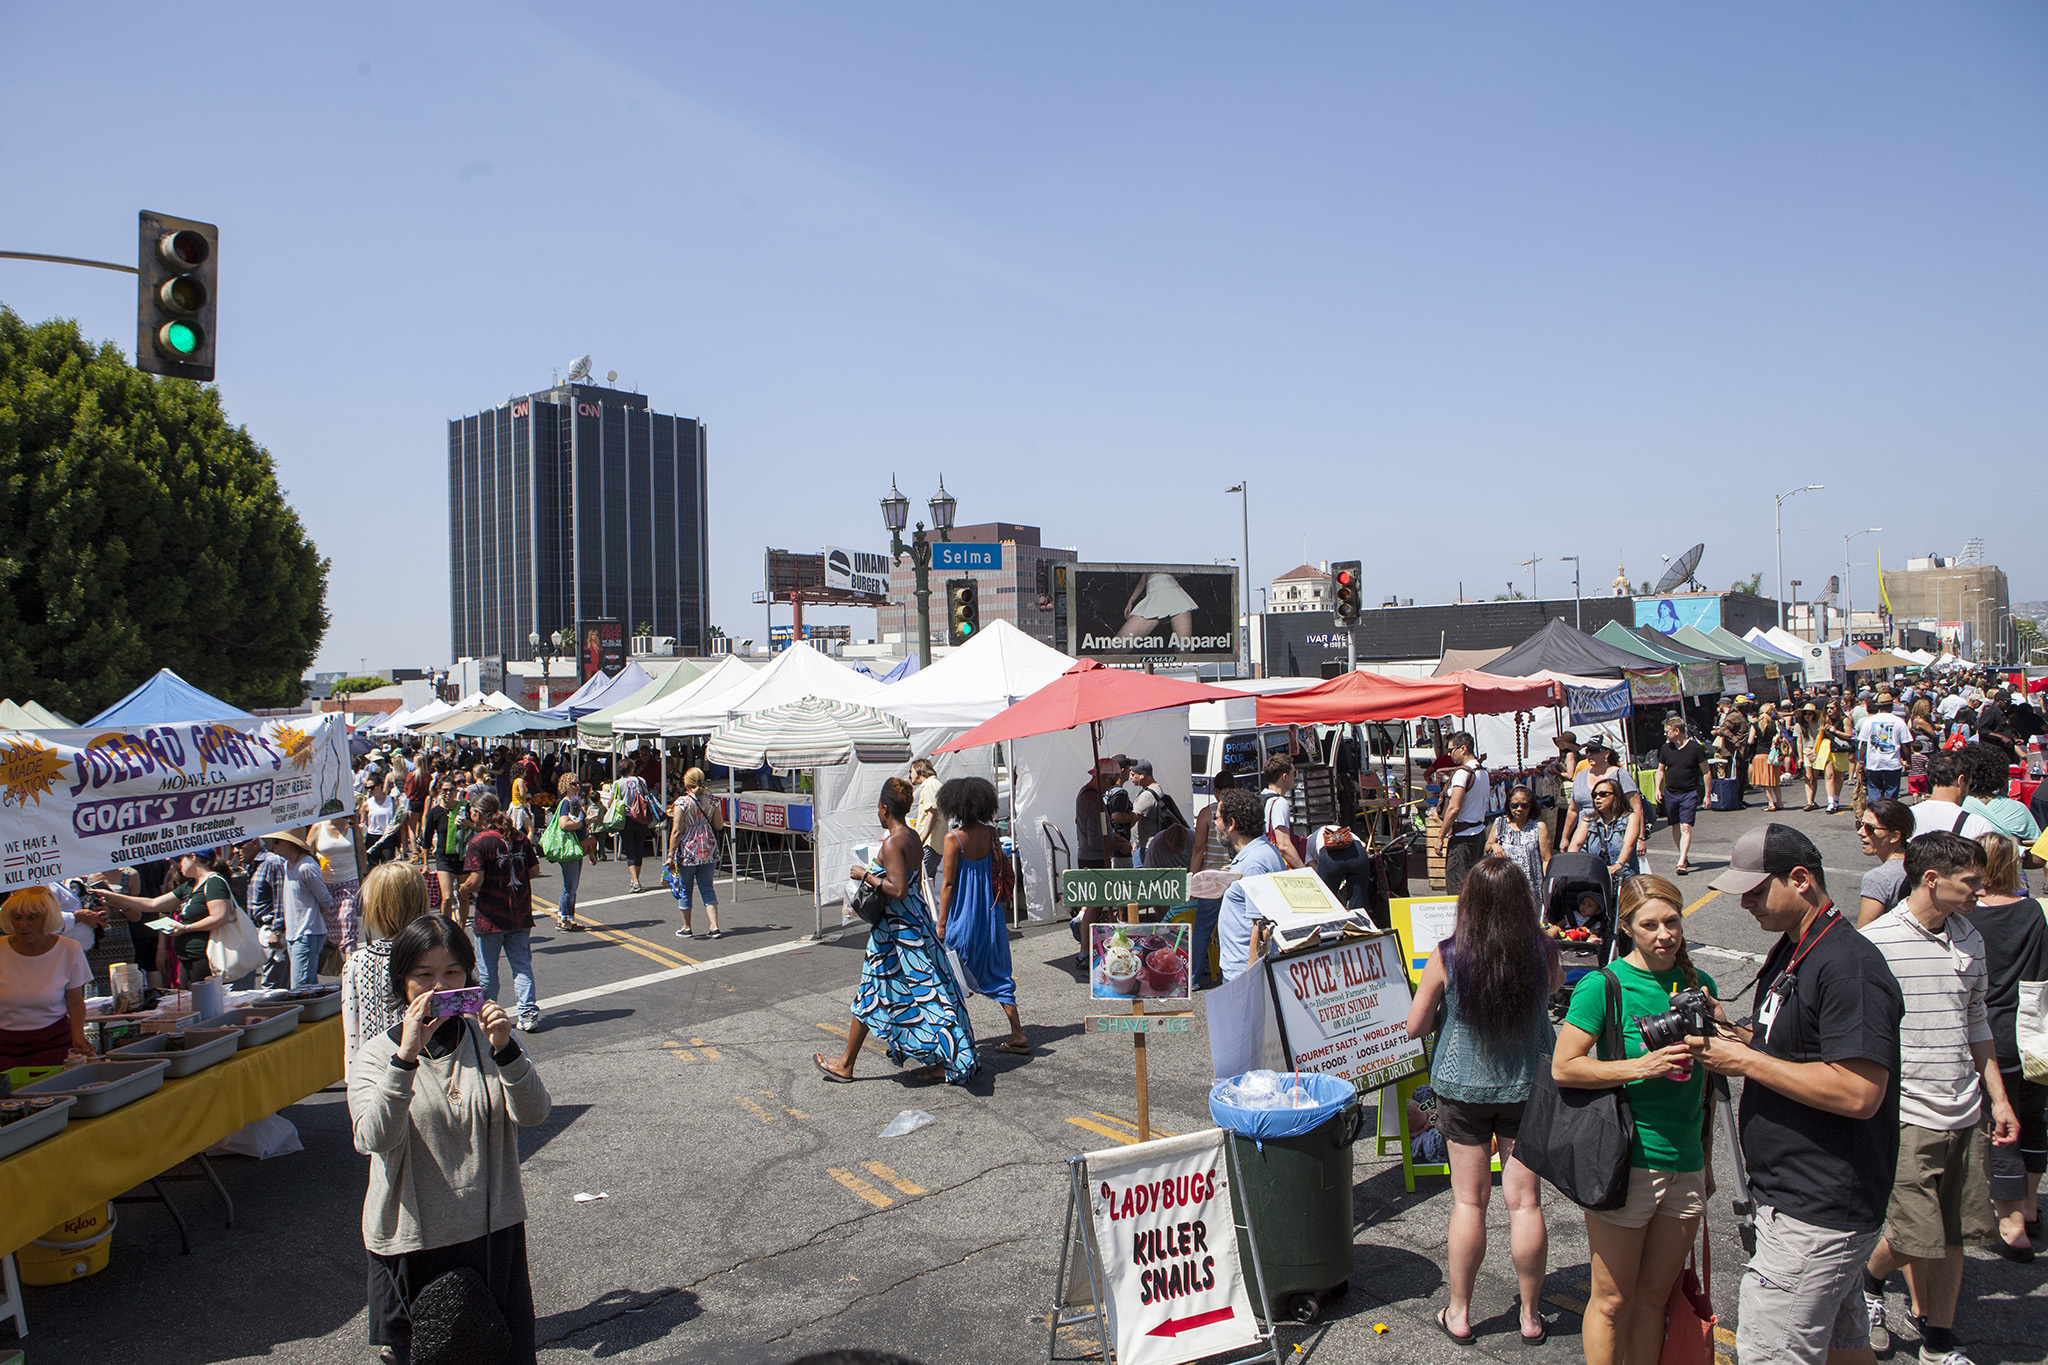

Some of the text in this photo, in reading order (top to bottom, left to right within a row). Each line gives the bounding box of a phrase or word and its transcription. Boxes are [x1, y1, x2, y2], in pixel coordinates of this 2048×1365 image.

[513, 402, 529, 418] CNN
[577, 403, 601, 418] CNN
[853, 552, 890, 575] UMAMI
[943, 549, 992, 564] Selma
[851, 573, 881, 594] BURGER
[601, 631, 622, 640] FREE
[1081, 632, 1231, 651] American Apparel
[1306, 633, 1348, 644] IVAR AVE
[9, 758, 43, 783] MADE
[69, 726, 185, 797] SOLEDAD
[191, 725, 282, 771] GOAT'S
[1224, 754, 1245, 764] SOUR
[3, 771, 58, 808] CREATIONS
[158, 770, 227, 792] MOJAVE, CA
[275, 778, 312, 797] GOAT RESCUE
[76, 781, 273, 832] GOAT'S CHEESE
[741, 809, 757, 823] PORK
[765, 812, 784, 826] BEEF
[122, 816, 237, 847] Follow Us On Facebook
[4, 834, 58, 854] WE HAVE A
[110, 826, 246, 863] SOLEDADGOATSGOATCHEESE
[25, 851, 42, 866] NO
[4, 862, 63, 885] KILL POLICY
[1067, 879, 1181, 902] SNO CON AMOR
[1289, 941, 1388, 1001] SPICE ALLEY
[1316, 993, 1345, 1008] Hollywood
[1369, 981, 1388, 993] Market
[1318, 993, 1380, 1024] EVERY SUNDAY
[1097, 1017, 1190, 1033] SHAVE ICE
[1333, 1020, 1342, 1030] ON
[1355, 1011, 1372, 1025] ALLEY
[1295, 1044, 1334, 1065] GOURMET
[1335, 1036, 1359, 1052] SALTS
[1362, 1026, 1390, 1042] WORLD
[1321, 1055, 1348, 1071] FOODS
[1356, 1043, 1380, 1060] LOOSE
[1380, 1037, 1398, 1051] LEAF
[1356, 1054, 1396, 1075] COCKTAILS
[1409, 1048, 1420, 1057] MORE
[1367, 1069, 1386, 1088] BUY
[1387, 1059, 1416, 1081] DRINK
[1109, 1169, 1216, 1221] LADYBUGS
[64, 1216, 97, 1234] igloo
[1133, 1220, 1208, 1266] KILLER
[1140, 1255, 1216, 1306] SNAILS
